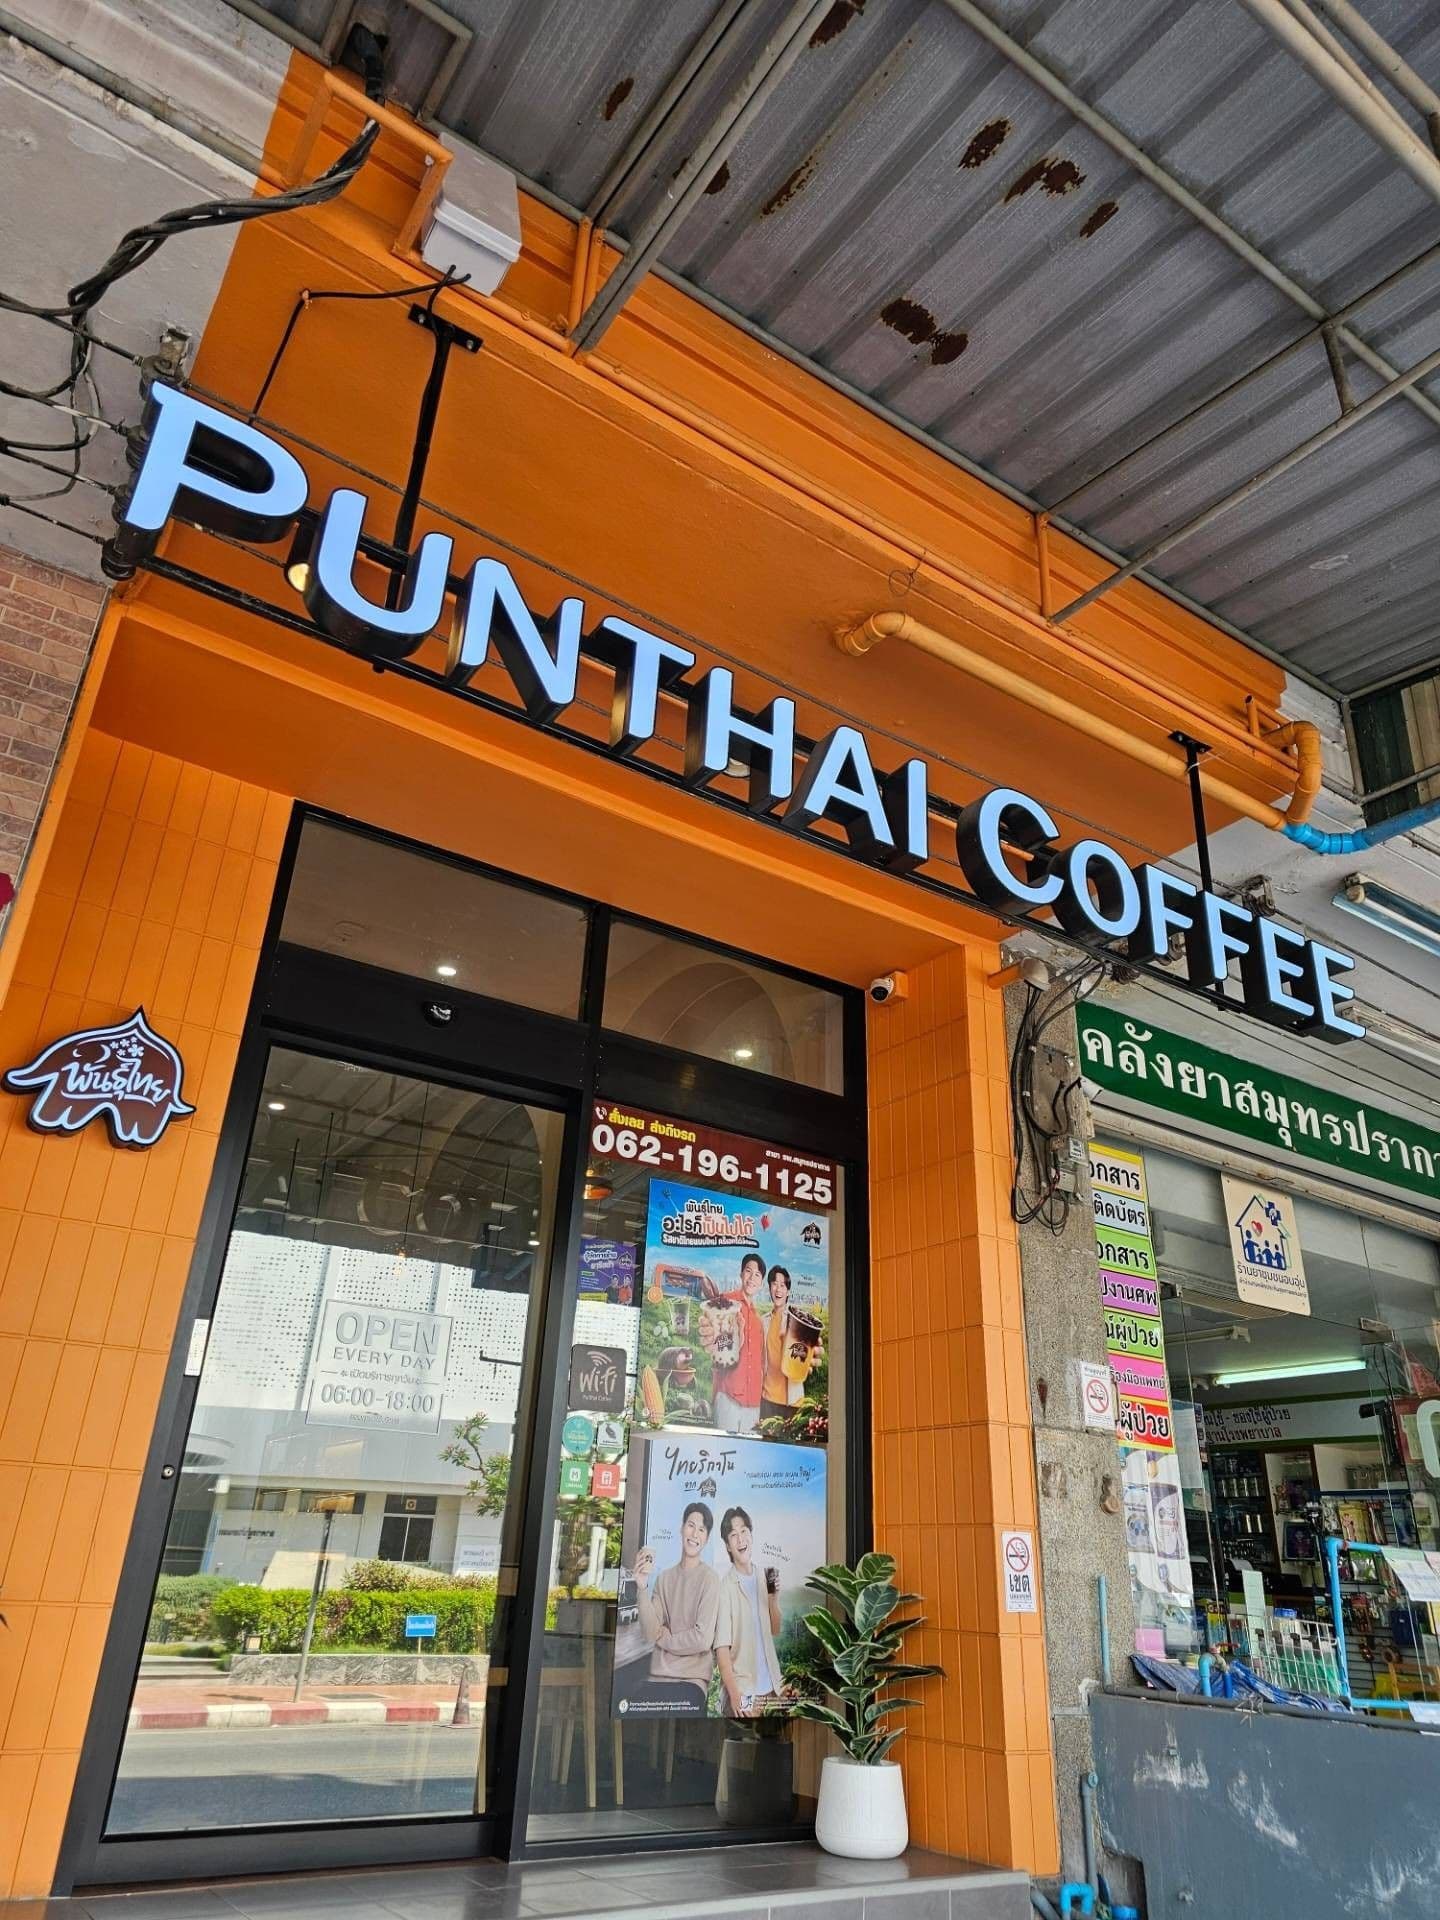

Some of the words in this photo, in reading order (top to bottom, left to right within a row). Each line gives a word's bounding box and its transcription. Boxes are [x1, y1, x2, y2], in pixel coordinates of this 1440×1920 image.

[124, 380, 932, 864] PUNTHAI
[980, 788, 1367, 1042] COFFEE
[608, 1107, 645, 1130] สั่งเลย
[1082, 1022, 1440, 1179] คลังยาสมุทรปราก
[592, 1124, 833, 1205] 062-196-1125
[335, 1311, 440, 1355] OPEN
[333, 1346, 393, 1366] EVERY
[400, 1354, 436, 1370] DAY
[320, 1383, 434, 1414] 06:00-18:00
